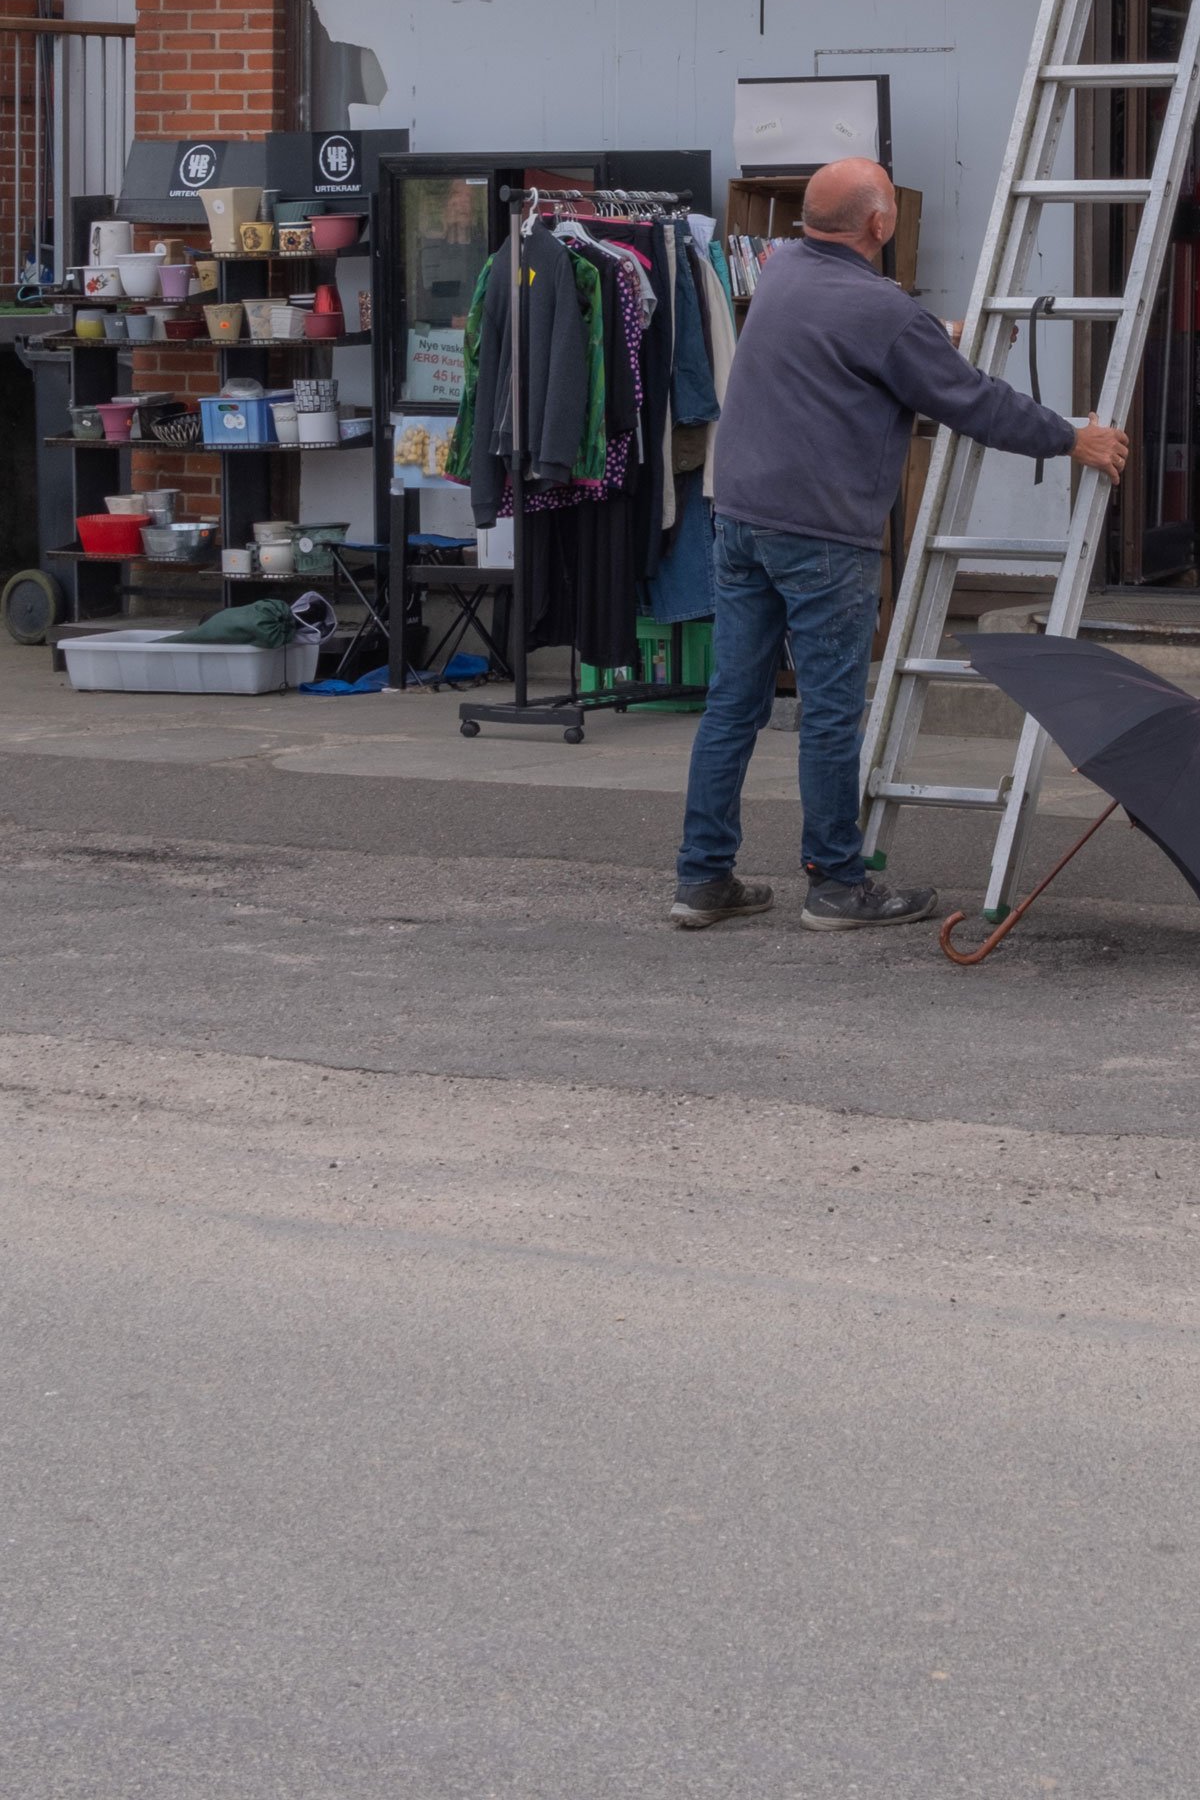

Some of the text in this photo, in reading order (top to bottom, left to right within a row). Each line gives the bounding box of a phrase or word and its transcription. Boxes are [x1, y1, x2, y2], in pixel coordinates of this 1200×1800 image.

[315, 184, 361, 193] URTEKRAM
[419, 340, 439, 352] Nye
[413, 352, 440, 365] ÆRØ
[432, 369, 462, 384] 45 kr
